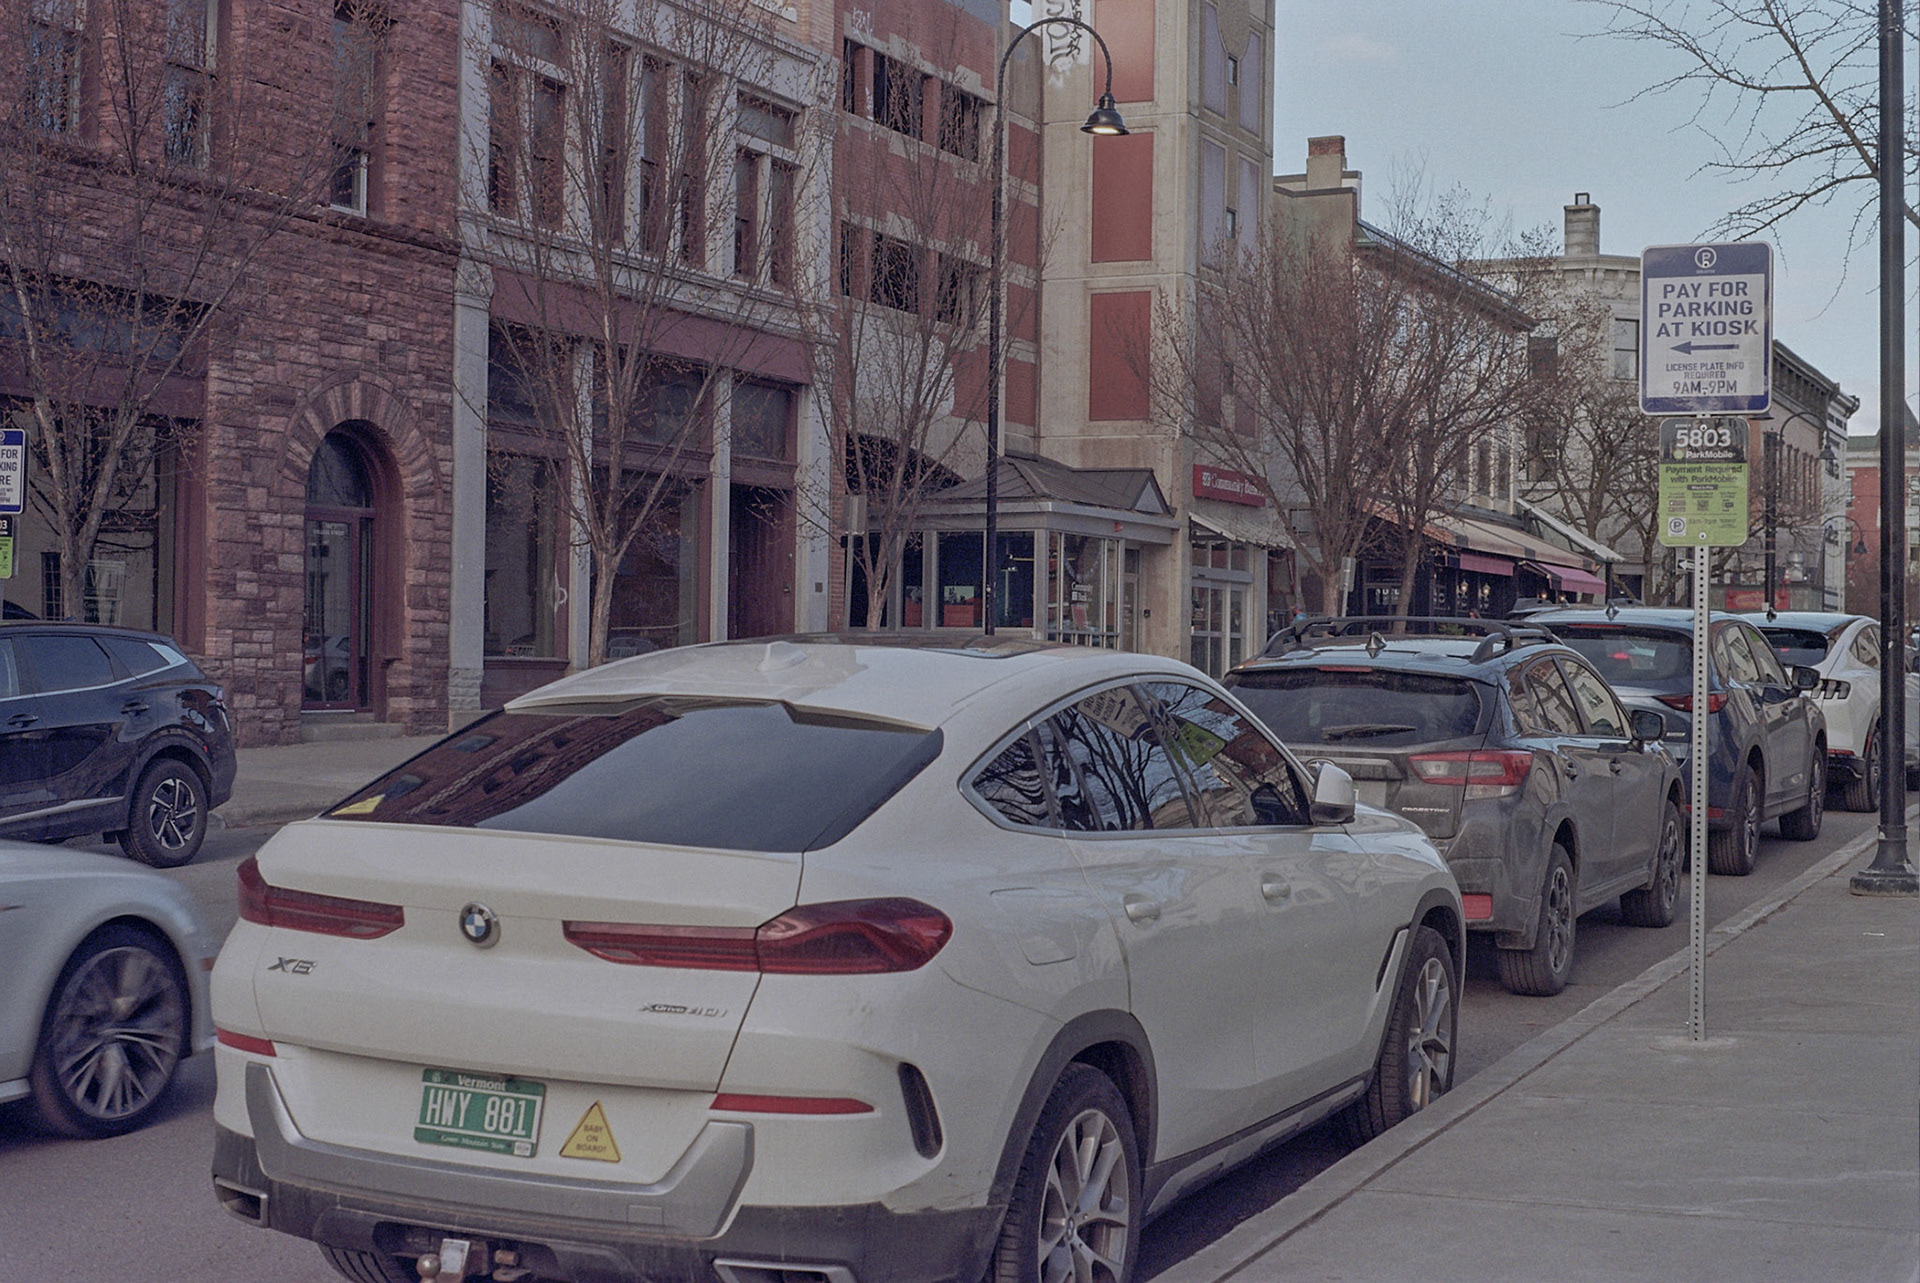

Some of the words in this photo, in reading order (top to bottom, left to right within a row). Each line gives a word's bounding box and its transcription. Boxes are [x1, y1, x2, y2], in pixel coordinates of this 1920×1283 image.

[1663, 283, 1702, 299] PAY
[1709, 281, 1748, 297] FOR
[1658, 300, 1753, 318] PARKING
[1656, 322, 1684, 338] AT
[1691, 319, 1759, 337] KIOSK
[1666, 362, 1698, 372] LICENSE
[1700, 362, 1725, 371] PLATE
[1726, 361, 1745, 370] INFO
[1684, 371, 1726, 379] REQUIRED
[1673, 380, 1737, 394] 9AM-9PM
[1676, 429, 1731, 448] 5803
[1, 449, 18, 459] FOR
[1686, 450, 1734, 459] ParkMobile
[1665, 465, 1702, 475] Payment
[1705, 464, 1742, 475] Required
[1212, 473, 1243, 497] Community
[1670, 475, 1688, 483] with
[1691, 474, 1738, 484] ParkMobile
[267, 956, 317, 975] X6
[457, 1074, 507, 1092] Vermont
[426, 1088, 472, 1128] HWY
[484, 1096, 526, 1136] 881
[584, 1124, 604, 1133] BABY
[462, 1138, 489, 1148] Mountain
[586, 1134, 599, 1142] ON
